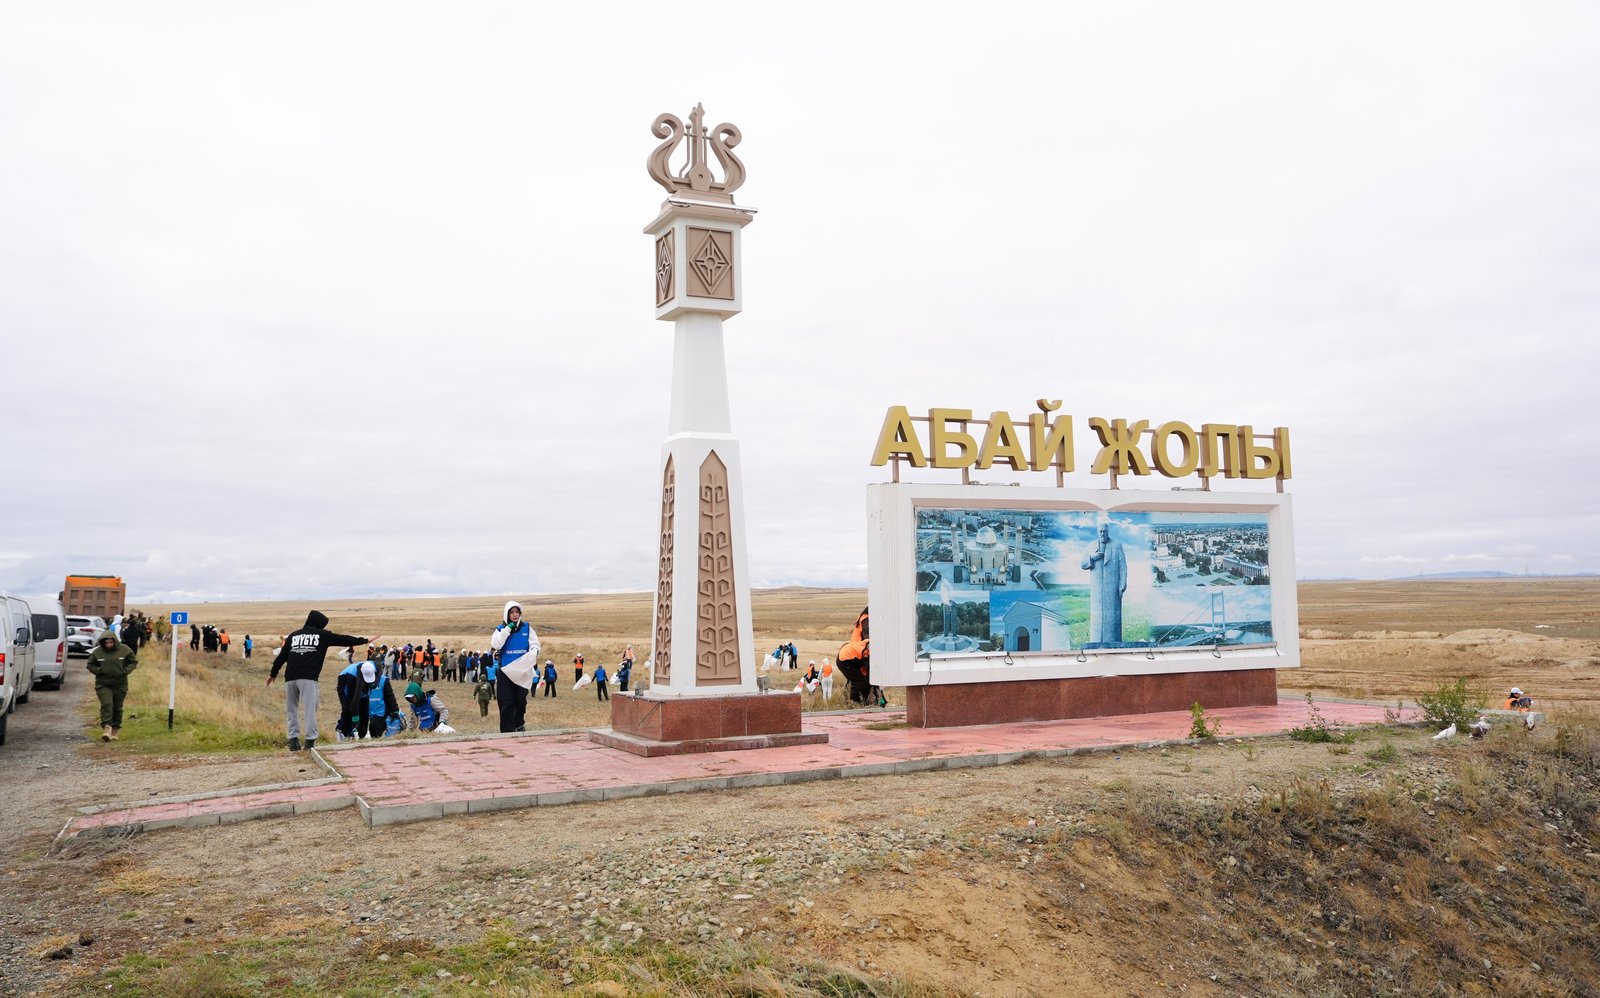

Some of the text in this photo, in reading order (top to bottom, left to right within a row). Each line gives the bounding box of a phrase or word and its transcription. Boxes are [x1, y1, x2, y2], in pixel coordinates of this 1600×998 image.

[870, 399, 1292, 479] АБАЙ ЖОЛЫ
[177, 614, 182, 623] 0
